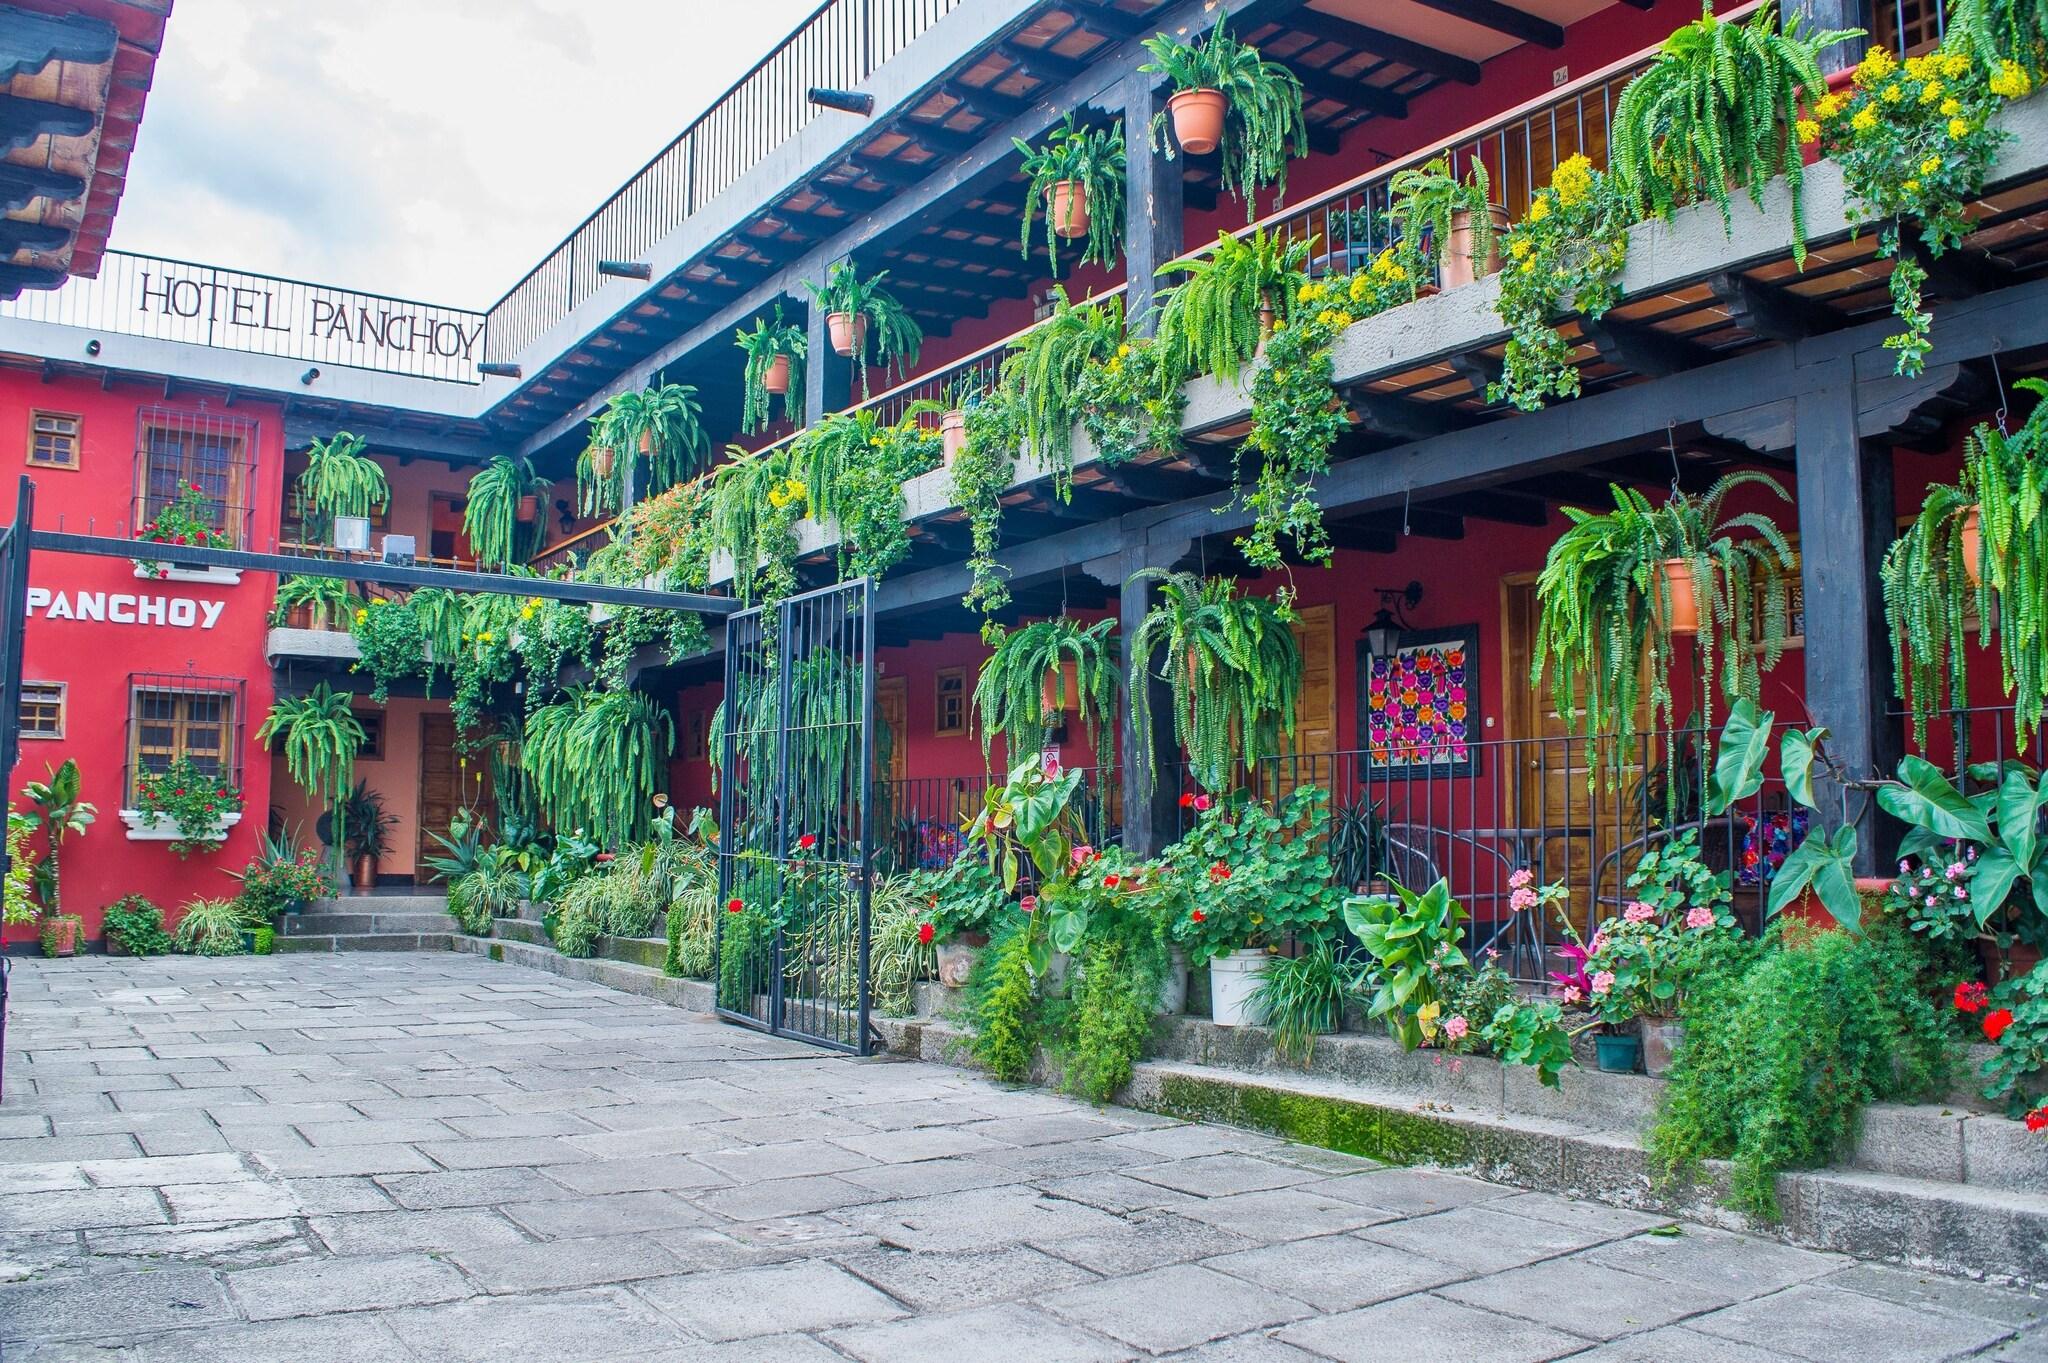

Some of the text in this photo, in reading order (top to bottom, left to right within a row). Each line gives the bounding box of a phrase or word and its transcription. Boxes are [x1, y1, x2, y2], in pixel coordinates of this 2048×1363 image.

[138, 271, 484, 361] HOTEL PANCHOY
[26, 587, 226, 629] PANCHOY
